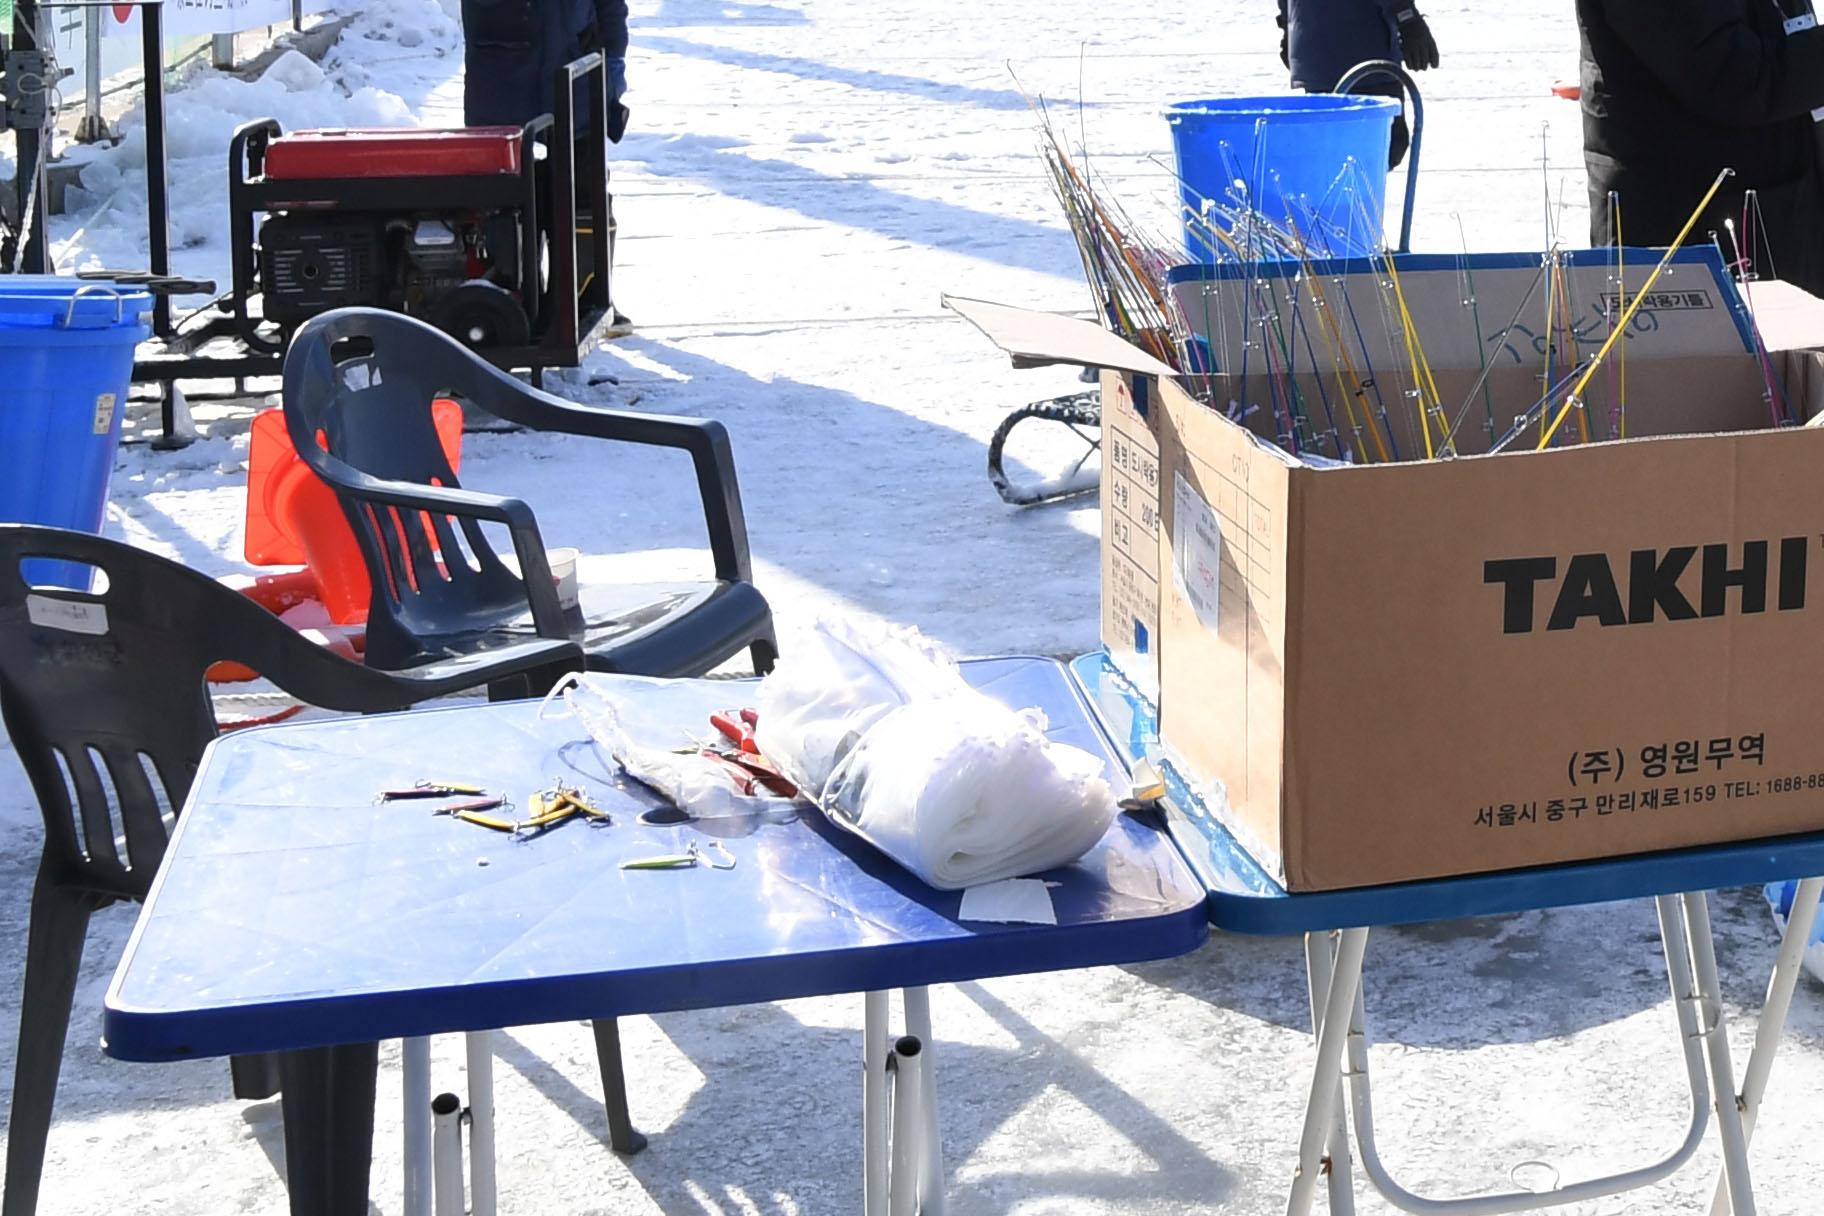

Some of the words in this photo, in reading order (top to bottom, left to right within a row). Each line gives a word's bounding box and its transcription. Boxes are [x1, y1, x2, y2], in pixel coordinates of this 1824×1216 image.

[1483, 536, 1808, 635] TAKHI
[1567, 747, 1625, 786] (주)
[1639, 732, 1766, 781] 영원무역
[1473, 800, 1538, 828] 서울시
[1545, 797, 1589, 822] 중구
[1724, 781, 1761, 800] TEL:
